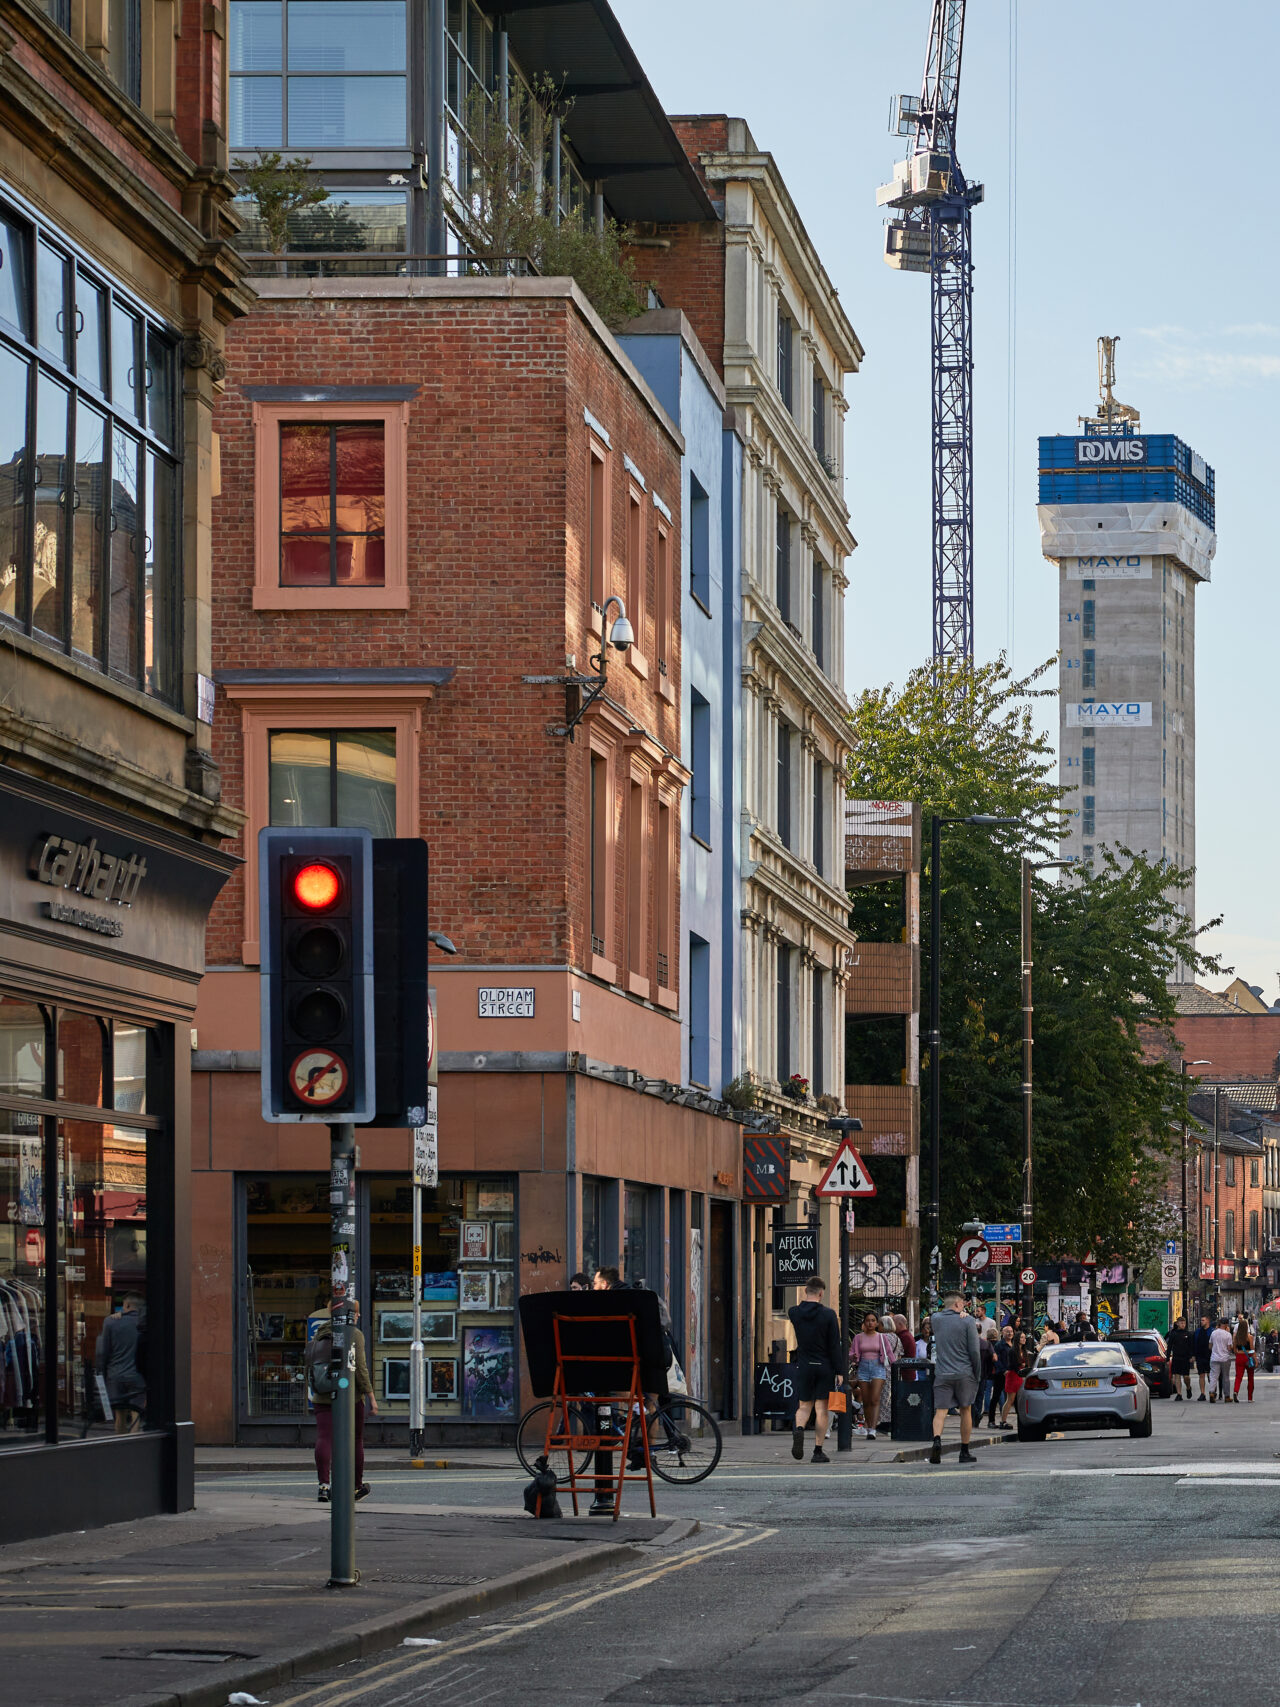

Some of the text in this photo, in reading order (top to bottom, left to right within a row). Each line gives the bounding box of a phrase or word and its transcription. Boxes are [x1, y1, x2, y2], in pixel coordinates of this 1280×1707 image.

[1078, 555, 1141, 567] MAYO
[1067, 612, 1080, 622] 14
[1078, 703, 1141, 715] MAYO
[39, 834, 147, 908] carhartt
[480, 990, 533, 1002] OLDHAM
[481, 1003, 531, 1015] STREET
[756, 1164, 775, 1175] MB
[779, 1236, 814, 1250] AFFLECK
[779, 1258, 814, 1272] BROWN
[1022, 1273, 1035, 1281] 20
